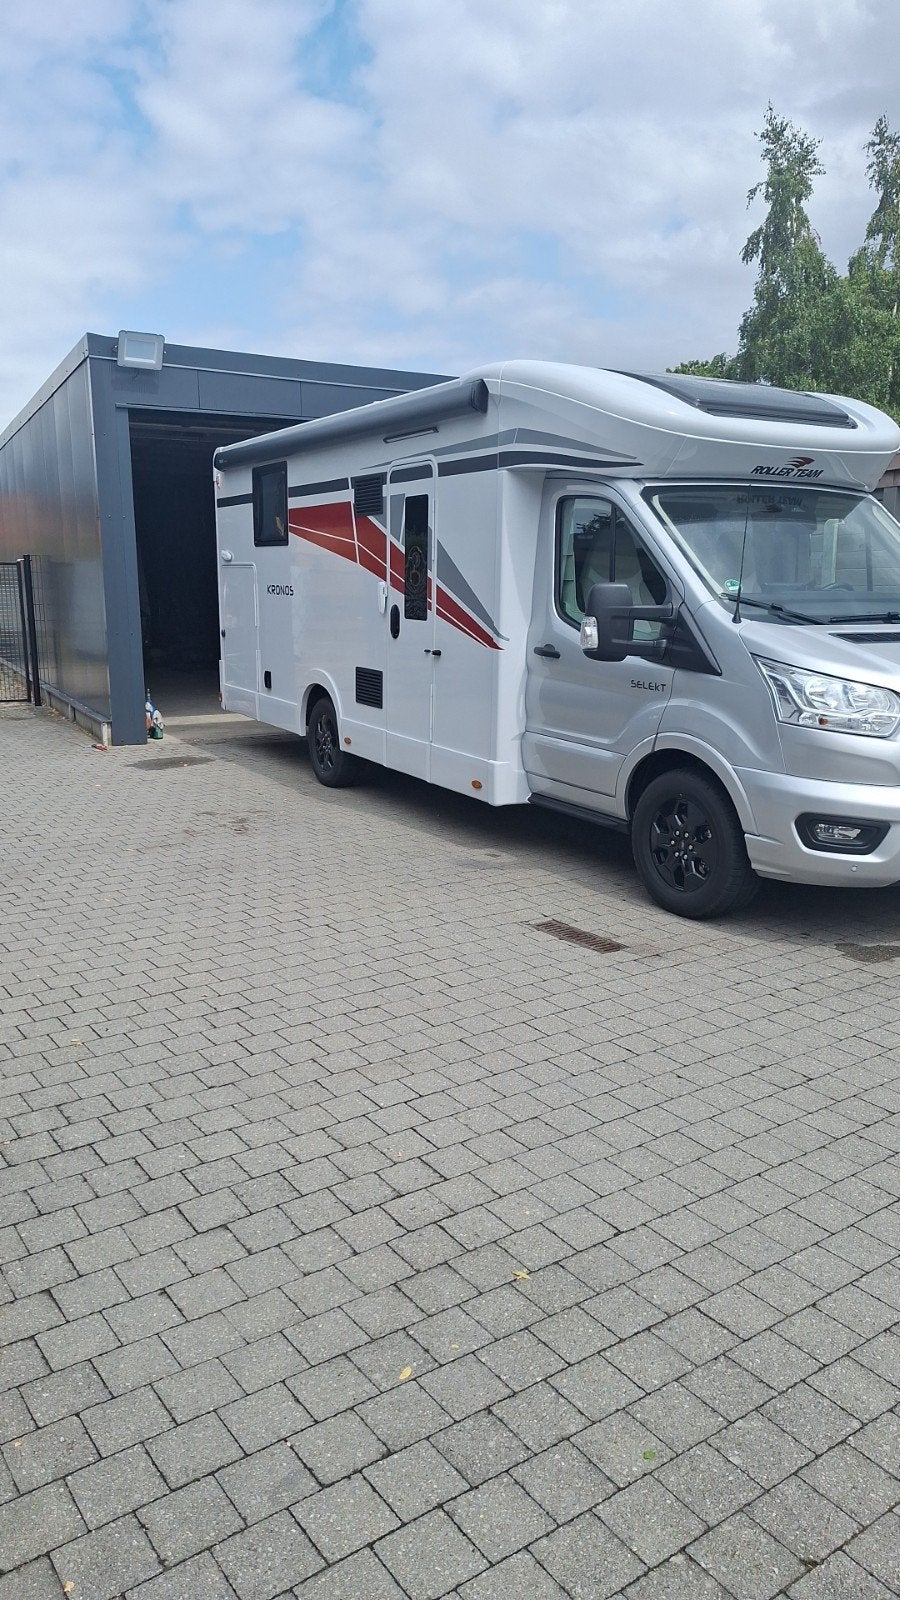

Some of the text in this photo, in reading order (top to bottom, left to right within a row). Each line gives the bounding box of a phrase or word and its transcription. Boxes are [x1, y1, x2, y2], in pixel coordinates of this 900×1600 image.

[750, 465, 825, 478] ROLLER TEAM
[266, 584, 294, 596] KRONOS
[630, 679, 667, 692] SELEKT
